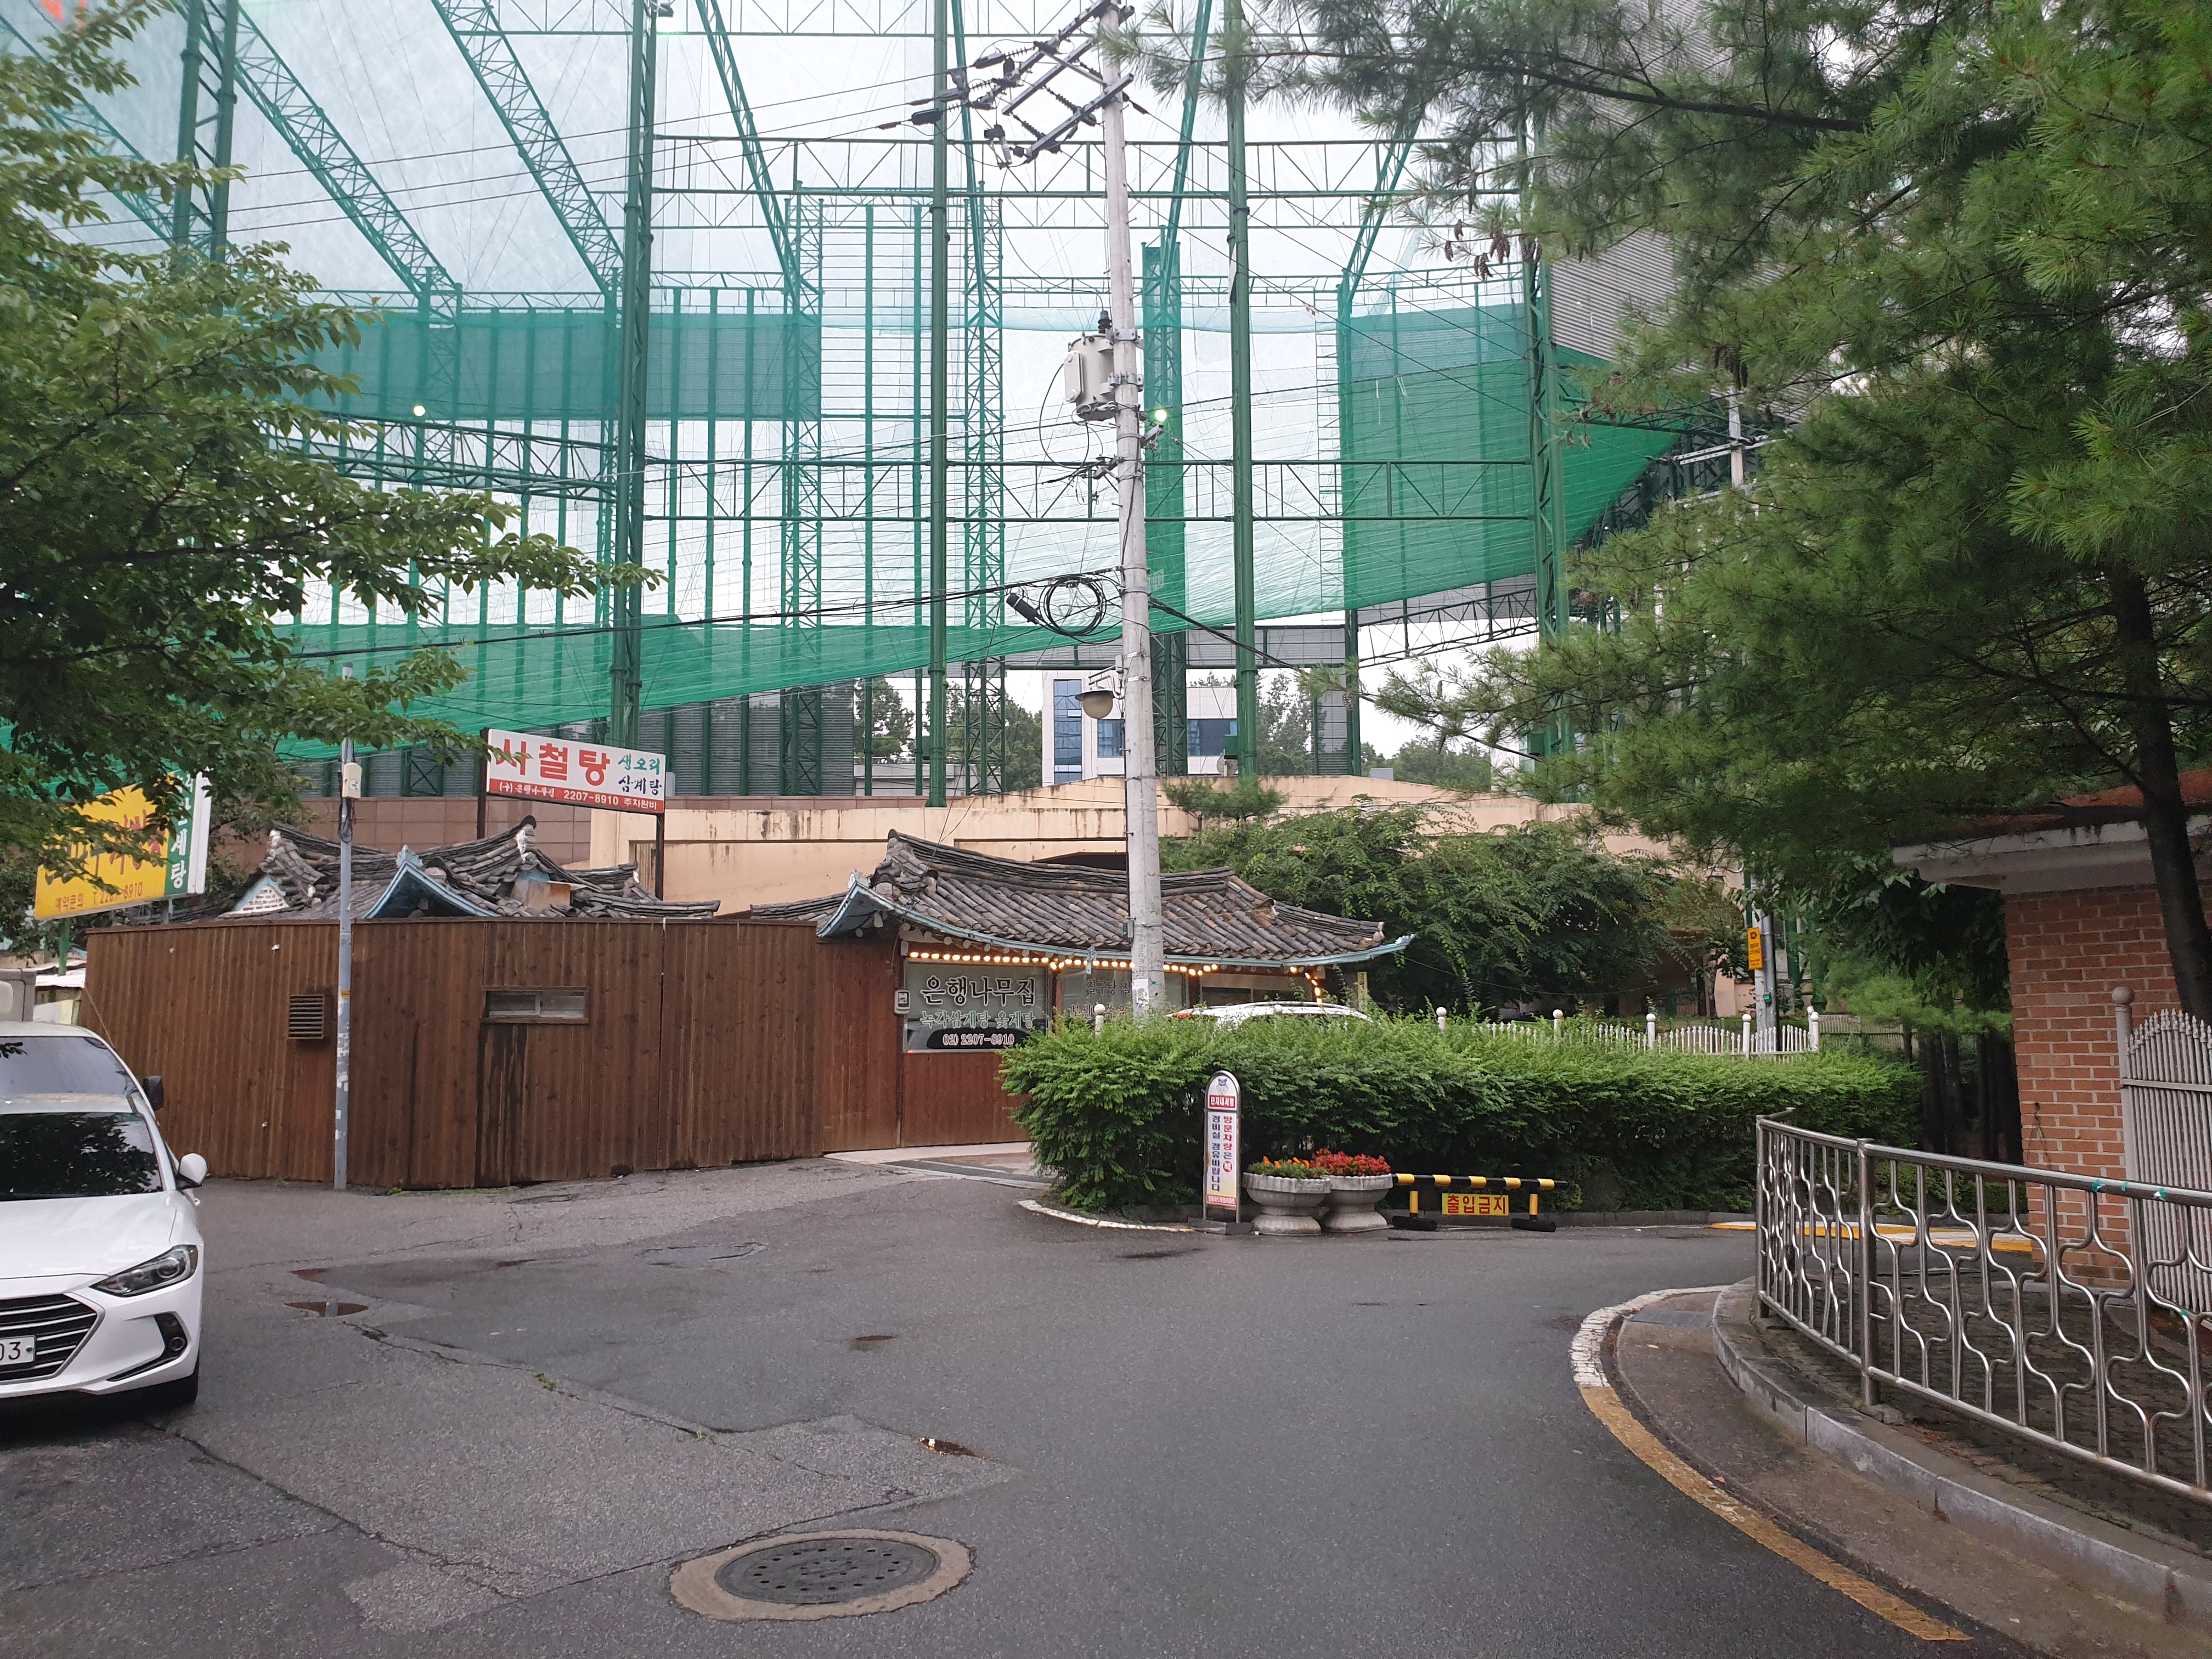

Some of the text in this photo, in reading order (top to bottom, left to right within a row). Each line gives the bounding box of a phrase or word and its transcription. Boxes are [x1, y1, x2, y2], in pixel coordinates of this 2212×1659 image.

[495, 738, 611, 786] 사철탕
[617, 753, 661, 775] 생오리
[618, 775, 663, 796] 삼계탕
[563, 789, 619, 806] 2207-8910
[624, 798, 658, 810] 주차완비
[919, 975, 1036, 1007] 은행나무집
[919, 1011, 991, 1029] 녹각삼계탕
[1211, 1115, 1220, 1192] 경비실 경유바랍니다
[1447, 1195, 1505, 1214] 출입금지
